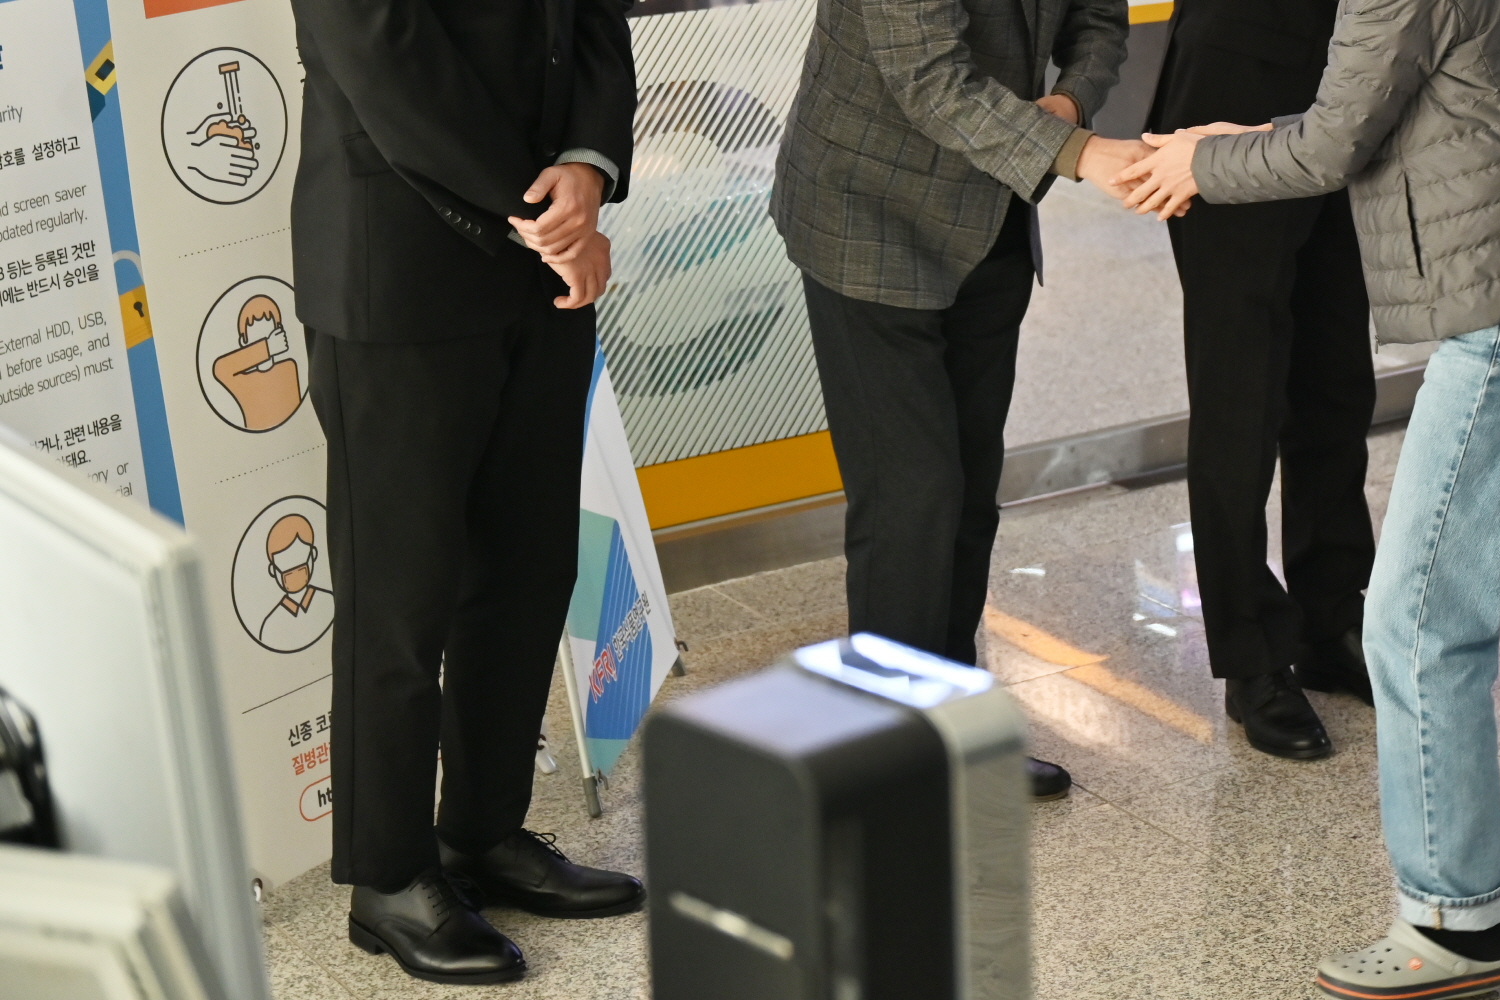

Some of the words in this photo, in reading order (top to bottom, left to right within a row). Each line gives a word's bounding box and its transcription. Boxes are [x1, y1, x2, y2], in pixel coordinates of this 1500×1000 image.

[32, 136, 81, 161] 설정하고
[13, 193, 50, 213] screen
[55, 184, 87, 204] saver
[36, 208, 88, 233] regularly.
[7, 259, 33, 281] 등)는
[35, 247, 69, 272] 등록된
[71, 240, 96, 260] 것만
[27, 273, 61, 299] 반드시
[63, 263, 100, 288] 승인을
[45, 320, 74, 340] HDD,
[77, 311, 107, 330] USB,
[6, 357, 43, 378] before
[47, 345, 83, 366] usage,
[87, 333, 110, 351] and
[37, 364, 81, 393] sources)
[84, 357, 114, 377] must
[64, 424, 87, 447] 관련
[87, 413, 122, 437] 내용을
[116, 462, 129, 476] or
[588, 642, 618, 704] KFRI
[288, 719, 313, 748] 신종
[291, 742, 332, 776] 질병관
